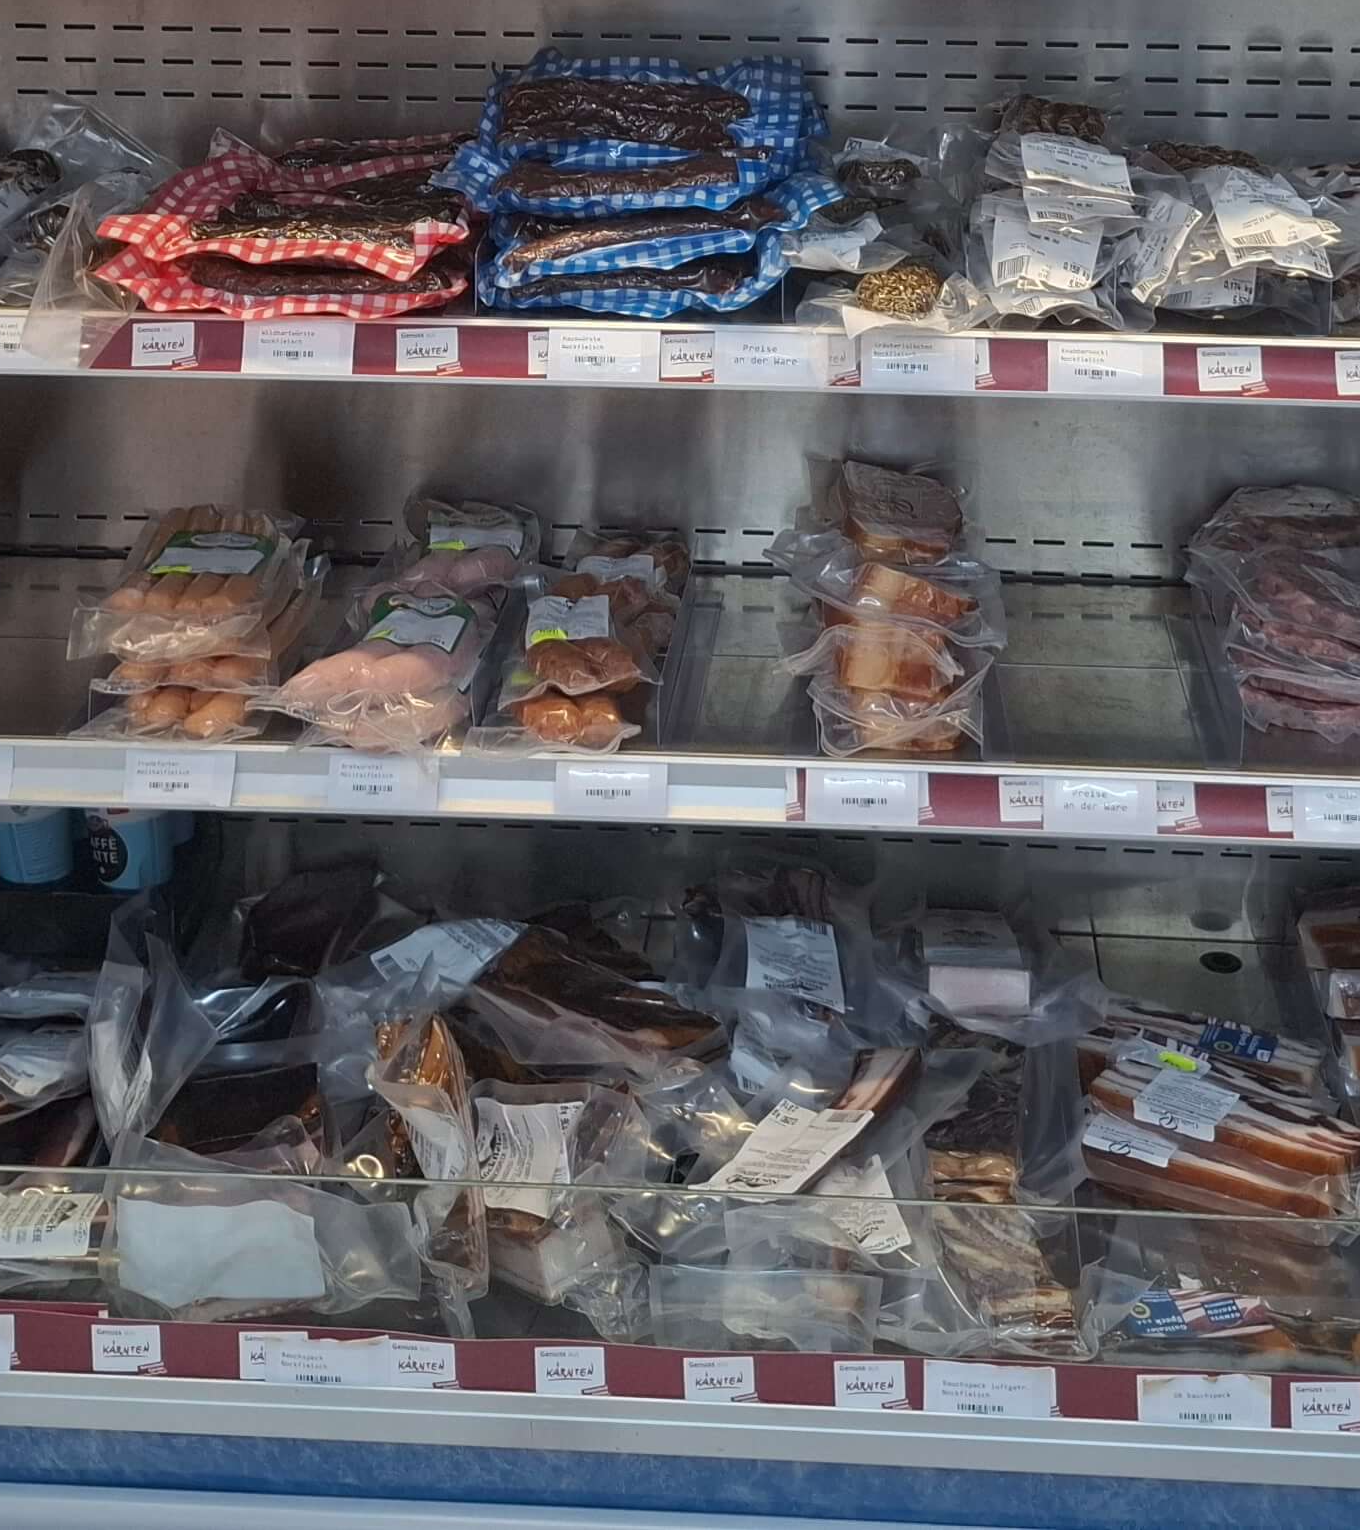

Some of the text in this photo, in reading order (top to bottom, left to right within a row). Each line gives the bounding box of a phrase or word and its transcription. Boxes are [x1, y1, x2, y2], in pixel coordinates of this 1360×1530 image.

[742, 343, 778, 353] Preise
[733, 355, 799, 366] an der Ware
[1080, 801, 1099, 811] der
